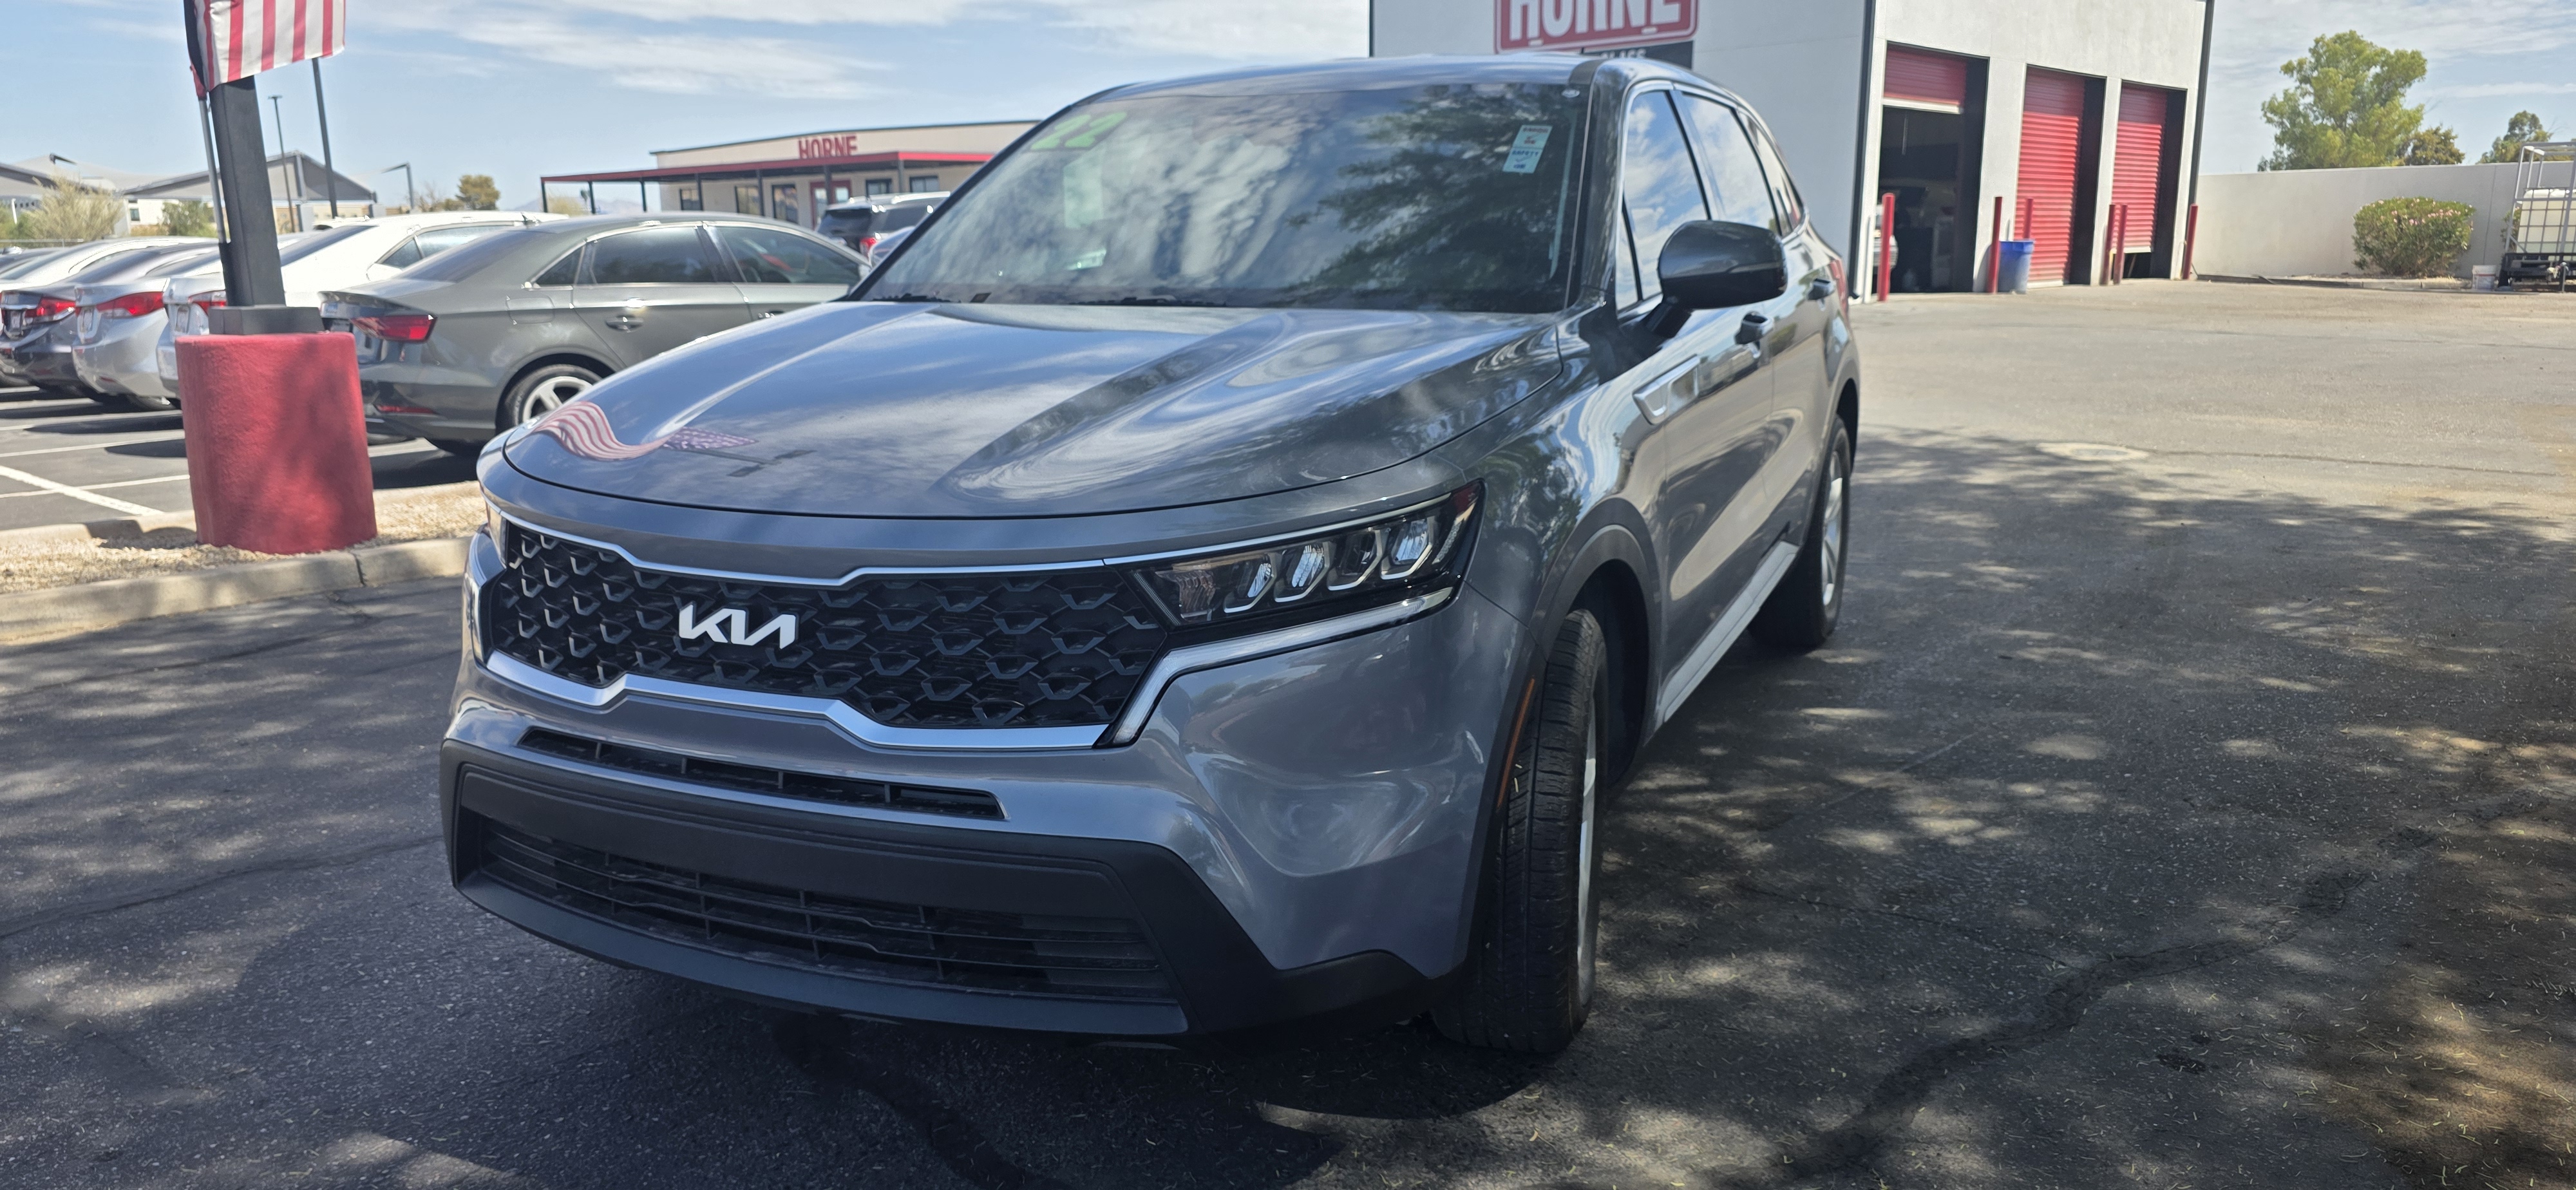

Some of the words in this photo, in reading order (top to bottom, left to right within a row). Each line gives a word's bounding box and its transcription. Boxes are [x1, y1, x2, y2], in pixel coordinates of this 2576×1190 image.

[798, 135, 858, 159] HORNE
[1030, 111, 1128, 150] 22
[679, 603, 797, 650] KIA
